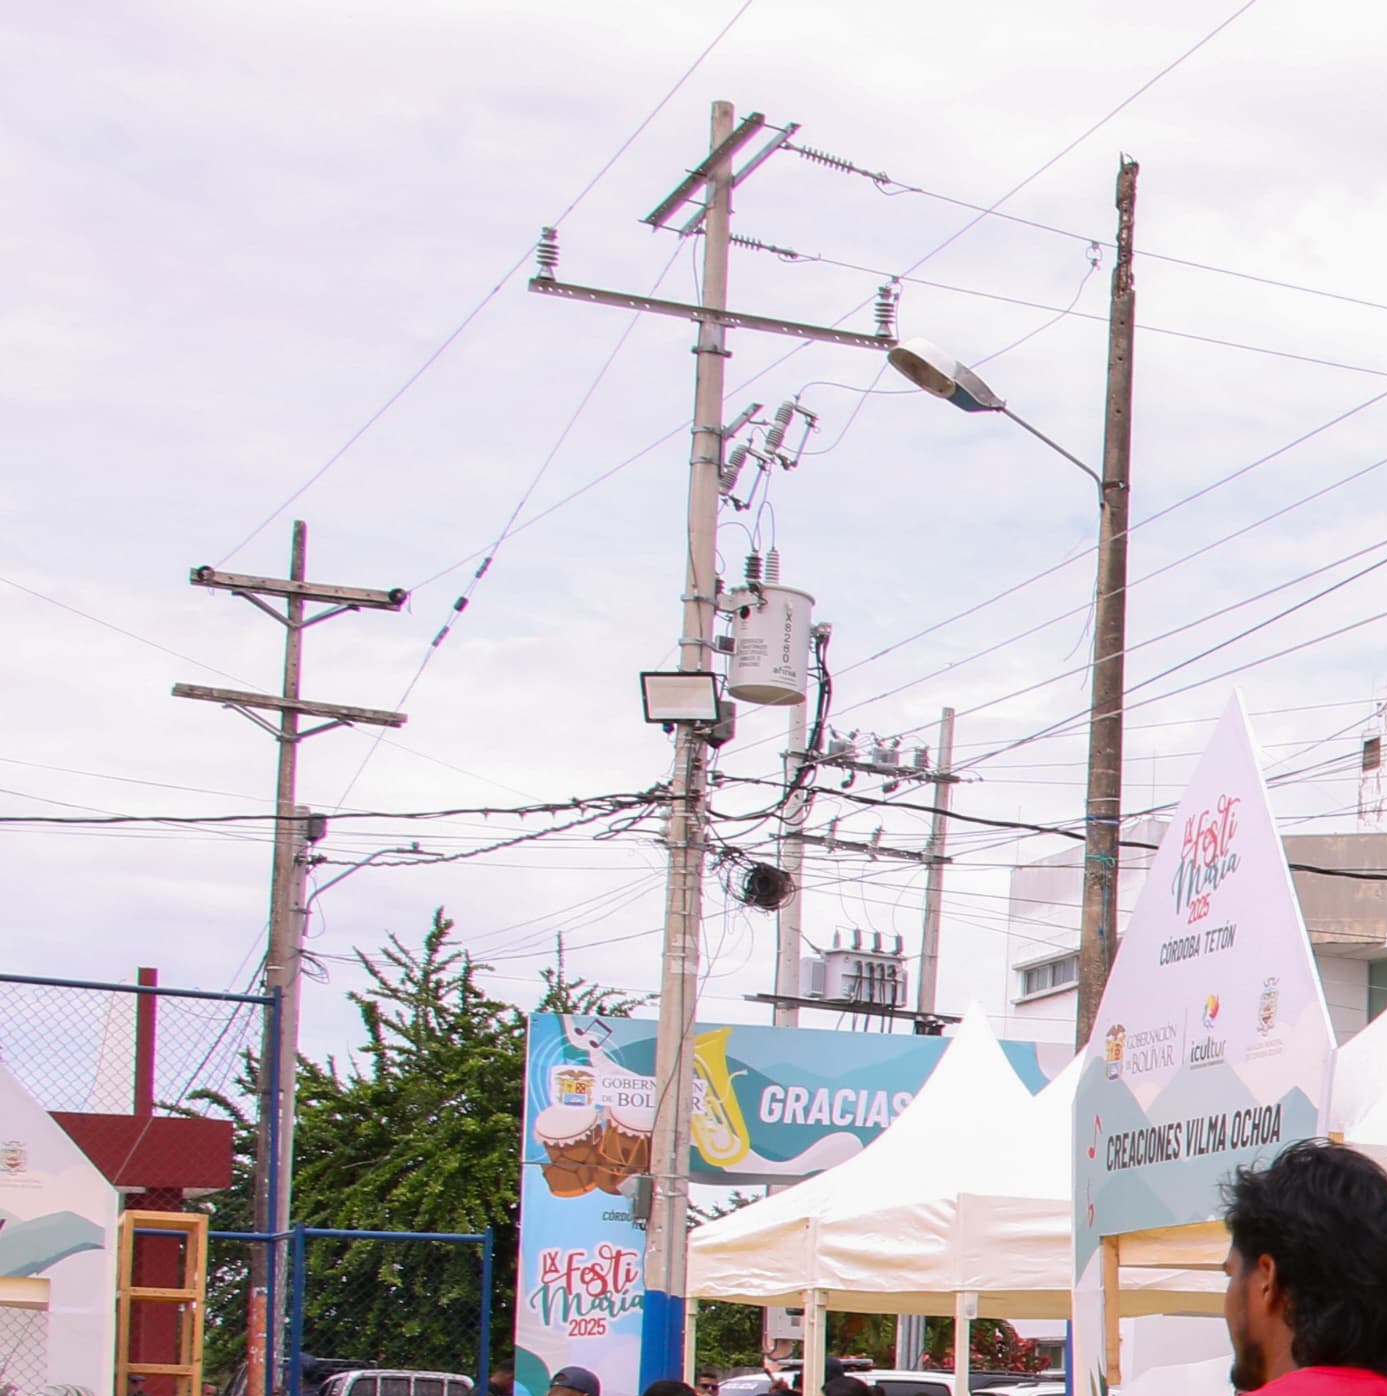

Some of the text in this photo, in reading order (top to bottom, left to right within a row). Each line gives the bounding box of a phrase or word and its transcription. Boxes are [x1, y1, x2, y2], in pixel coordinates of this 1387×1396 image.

[1181, 794, 1241, 870] Festi
[1159, 920, 1236, 966] CÓRDOBA TETÓN
[1190, 1036, 1226, 1063] icultur
[1106, 1103, 1282, 1172] CREACIONES VILMA OCHOA
[541, 1244, 638, 1297] IX Festi
[530, 1289, 644, 1326] María
[568, 1317, 607, 1337] 2025
